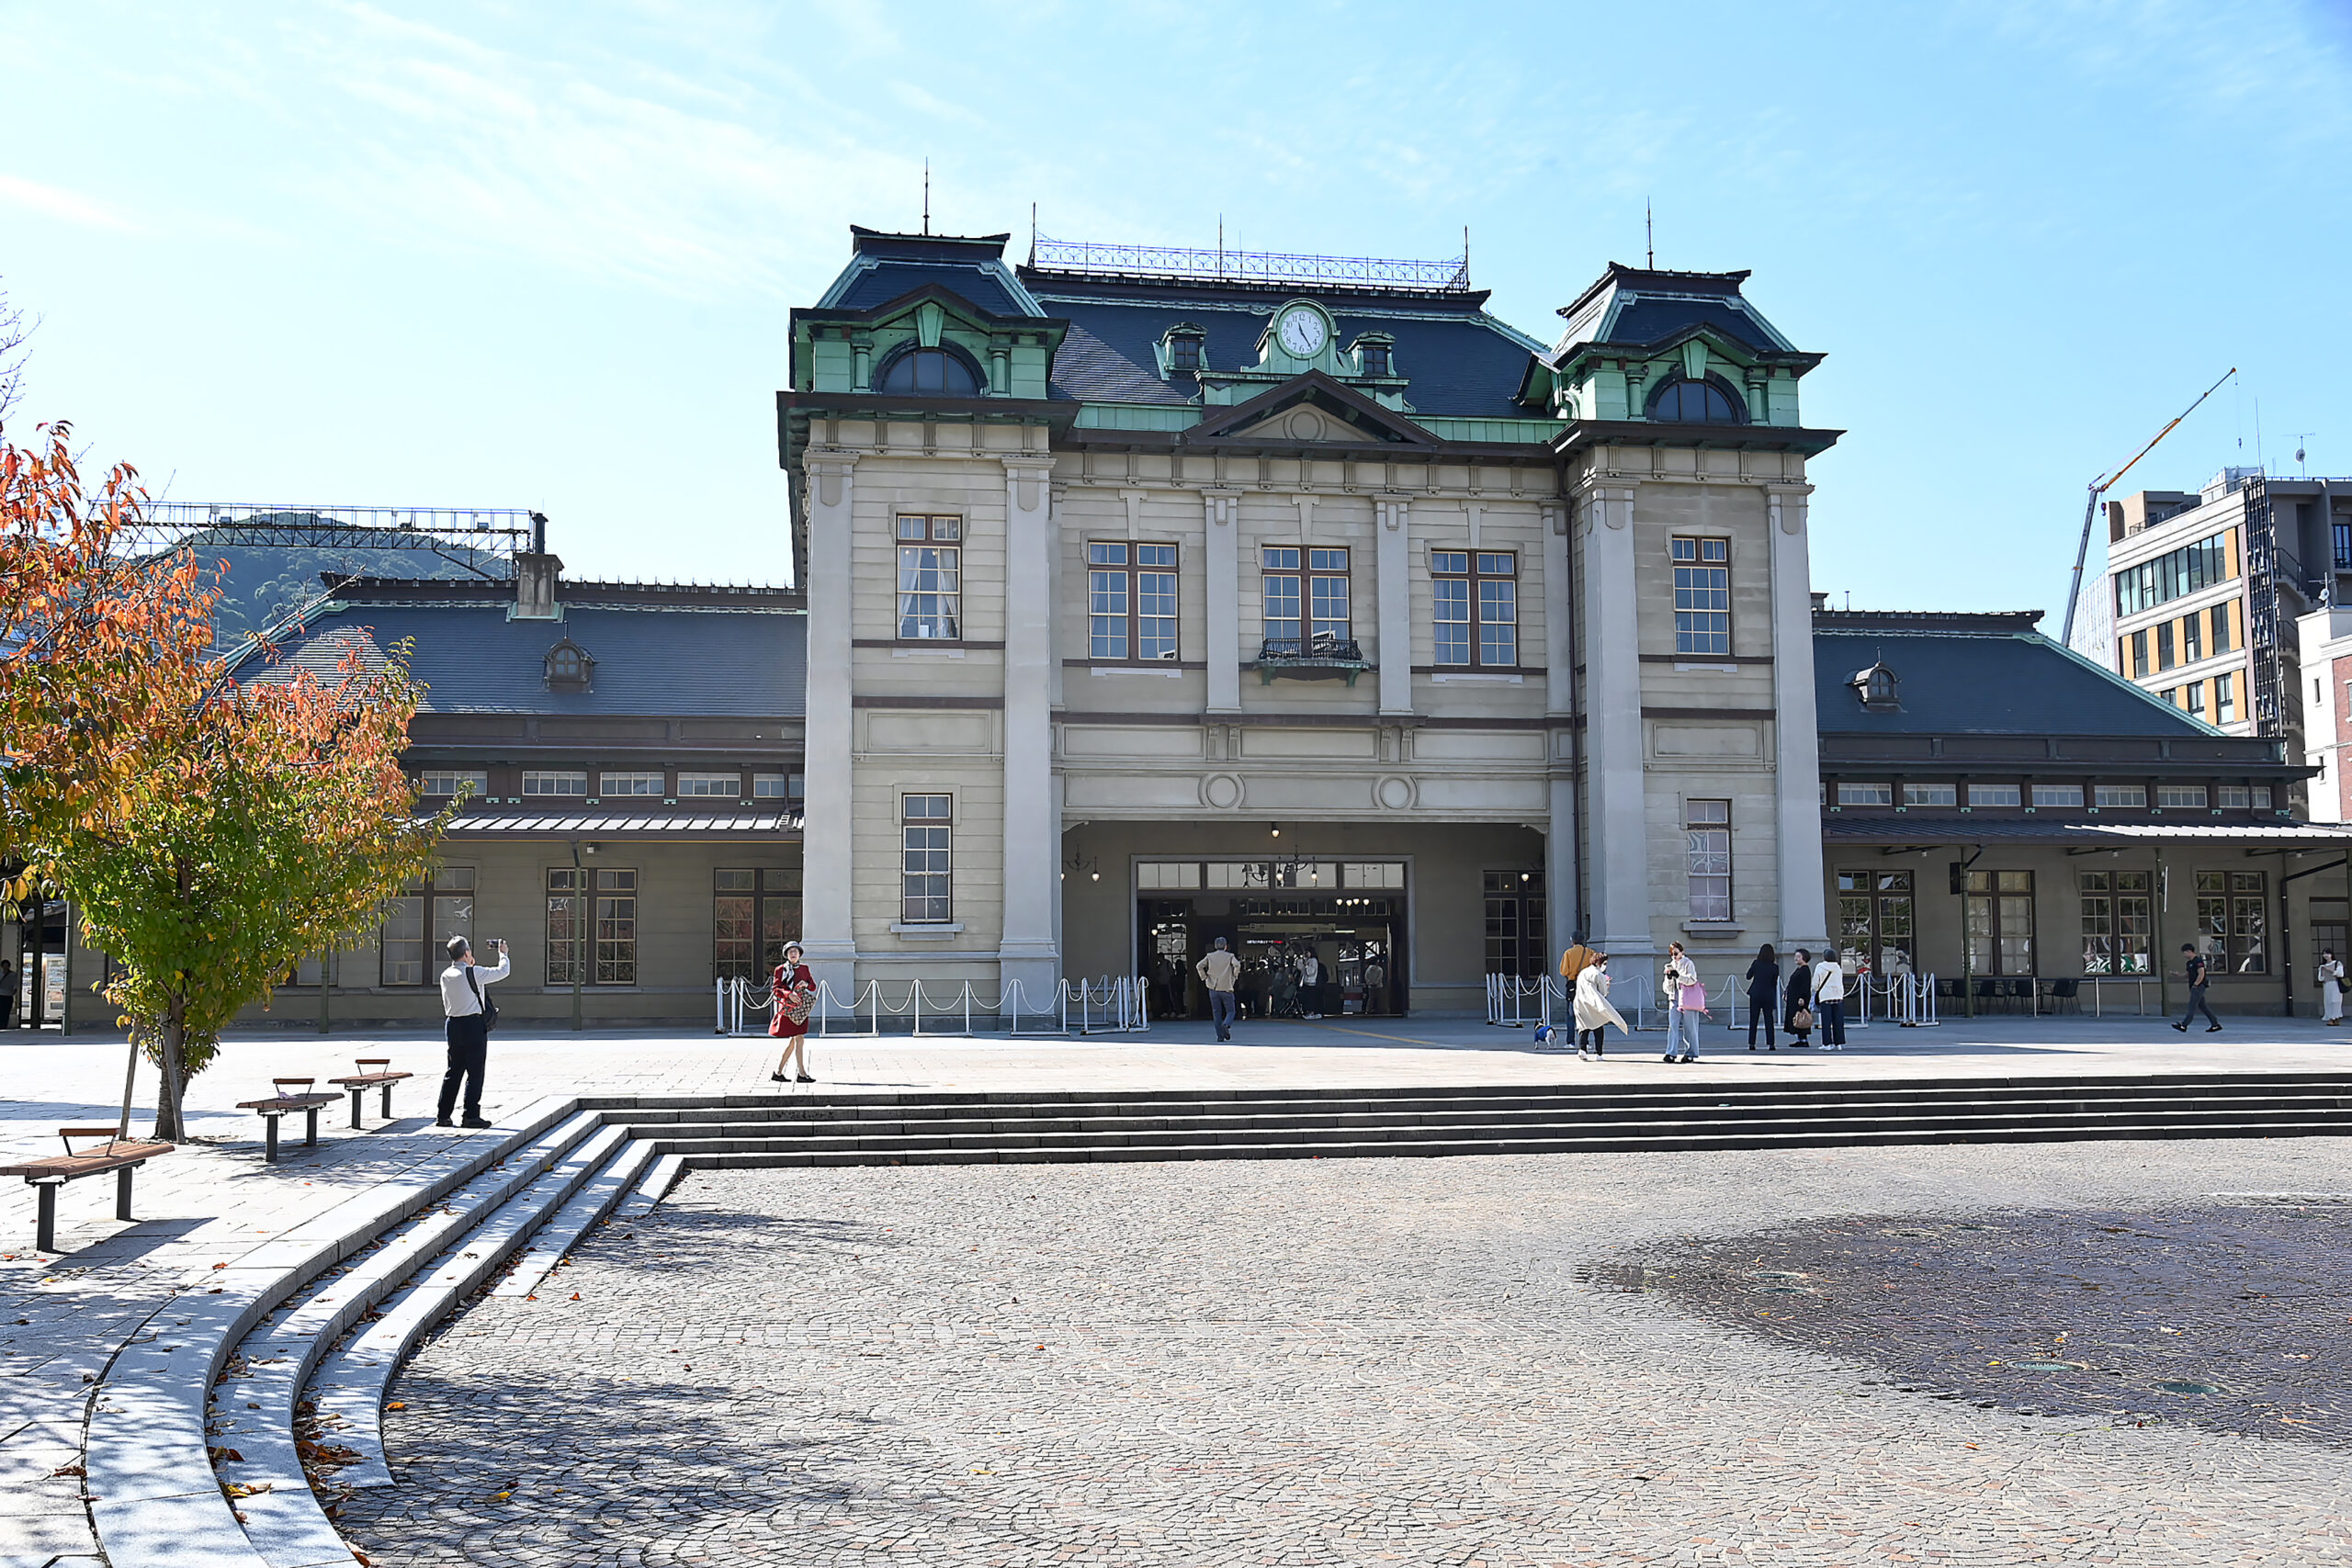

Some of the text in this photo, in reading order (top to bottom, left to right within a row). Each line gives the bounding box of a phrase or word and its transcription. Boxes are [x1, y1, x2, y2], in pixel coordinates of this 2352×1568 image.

[1314, 321, 1317, 330] 2
[1316, 330, 1320, 338] 3
[1293, 342, 1296, 350] 7
